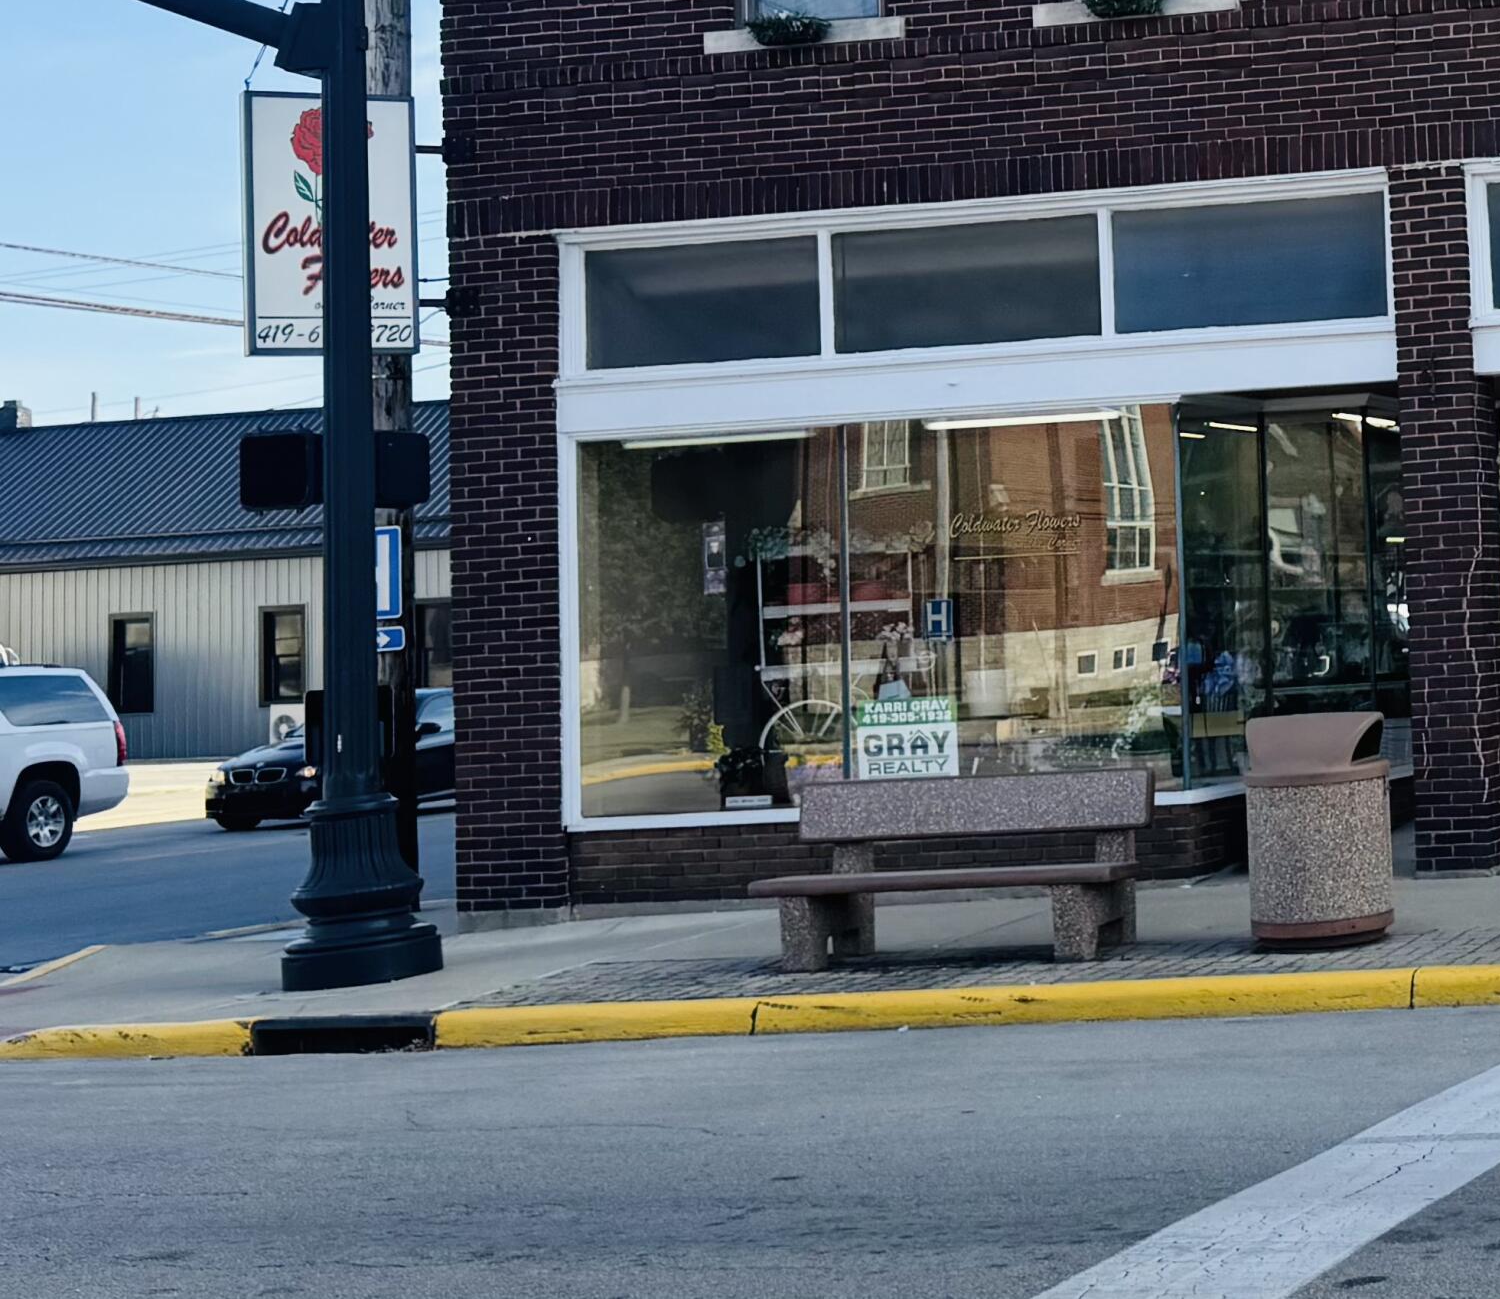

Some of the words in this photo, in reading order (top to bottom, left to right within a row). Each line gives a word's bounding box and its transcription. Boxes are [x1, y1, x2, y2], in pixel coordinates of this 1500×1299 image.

[262, 210, 398, 254] Coler
[301, 253, 405, 297] Fers
[370, 296, 406, 311] orner
[257, 322, 413, 345] 419-6720
[950, 512, 1020, 539] Coldwater
[1025, 509, 1082, 536] Flowers
[927, 602, 948, 633] H
[864, 701, 908, 714] KARRI
[910, 699, 949, 712] GRAY
[863, 730, 951, 758] GRAY
[868, 758, 949, 776] REALTY
